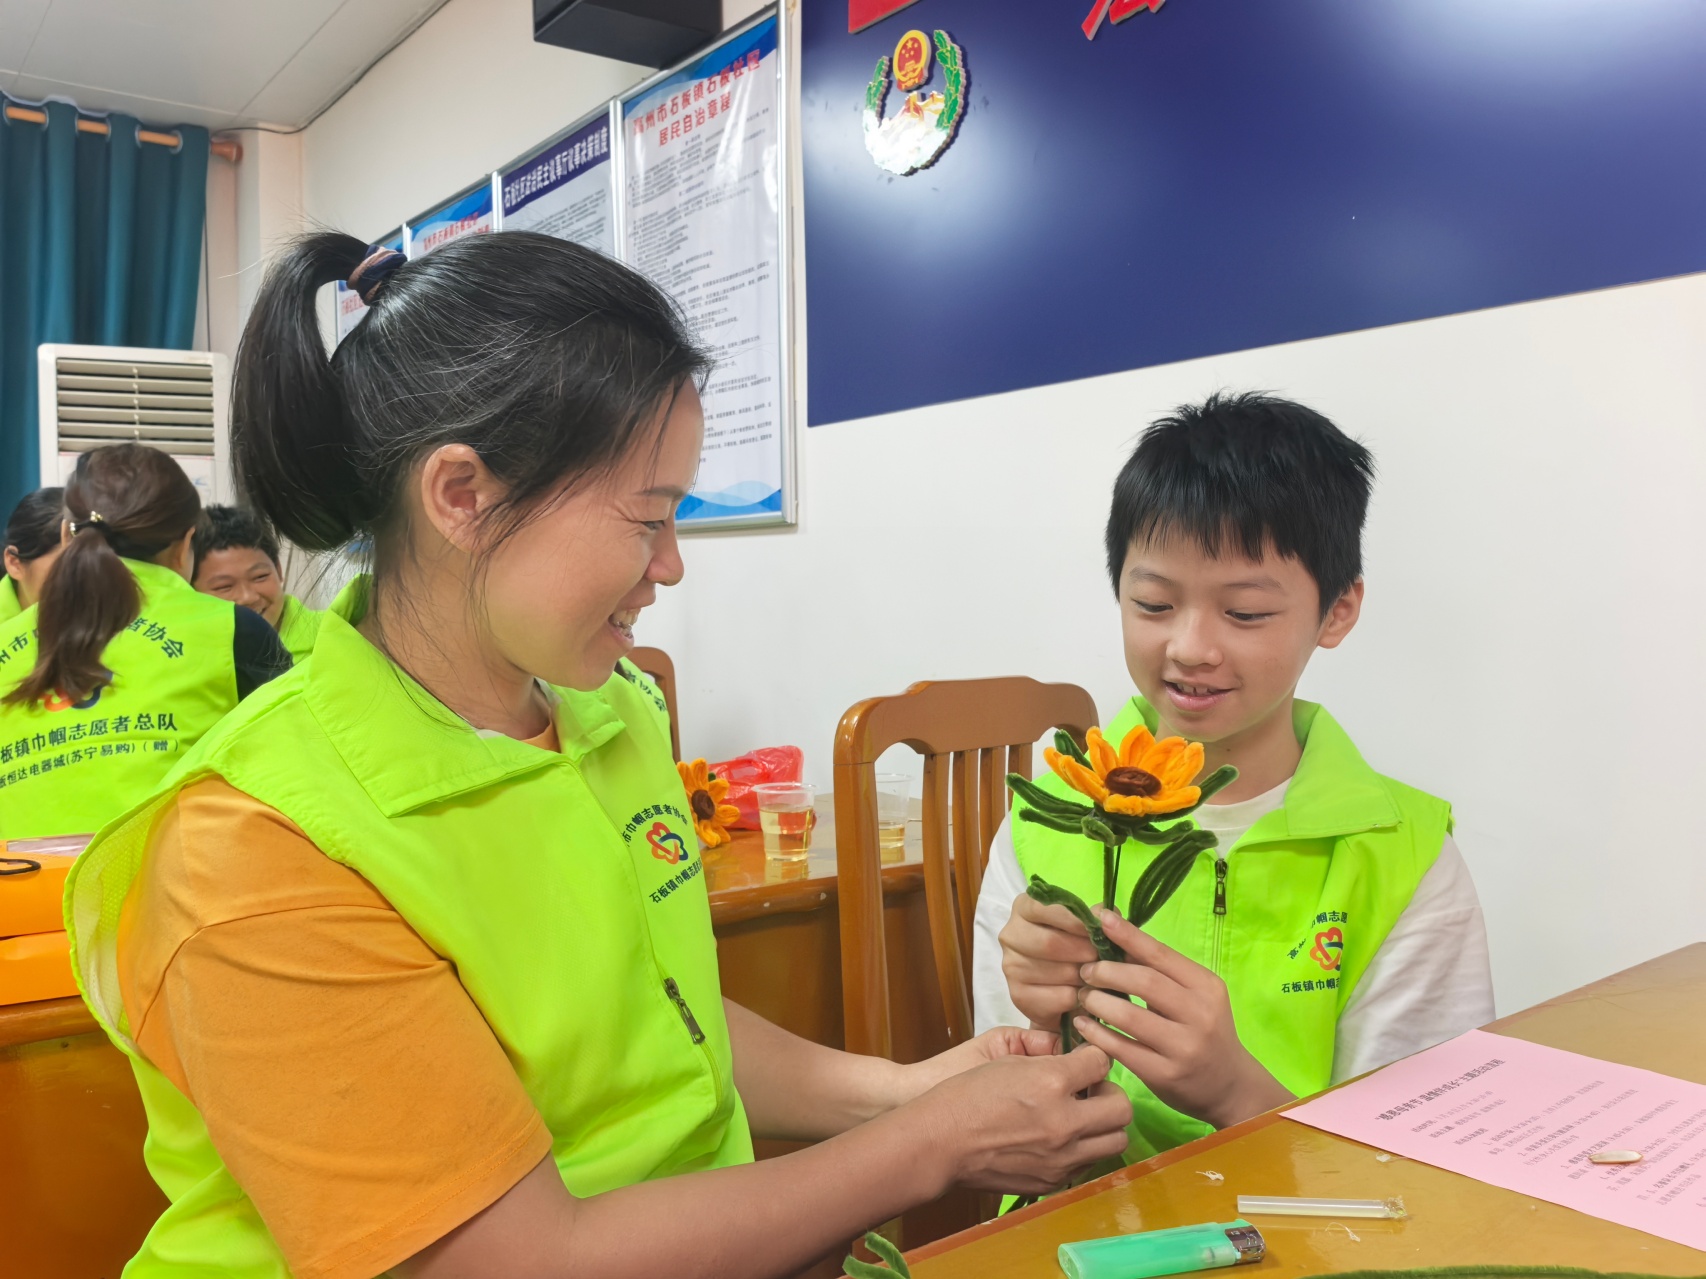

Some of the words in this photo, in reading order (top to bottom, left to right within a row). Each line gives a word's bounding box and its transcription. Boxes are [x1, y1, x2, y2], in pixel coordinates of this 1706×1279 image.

[633, 49, 760, 136] 高州市石板镇石板社区
[659, 91, 731, 147] 居民自治章程
